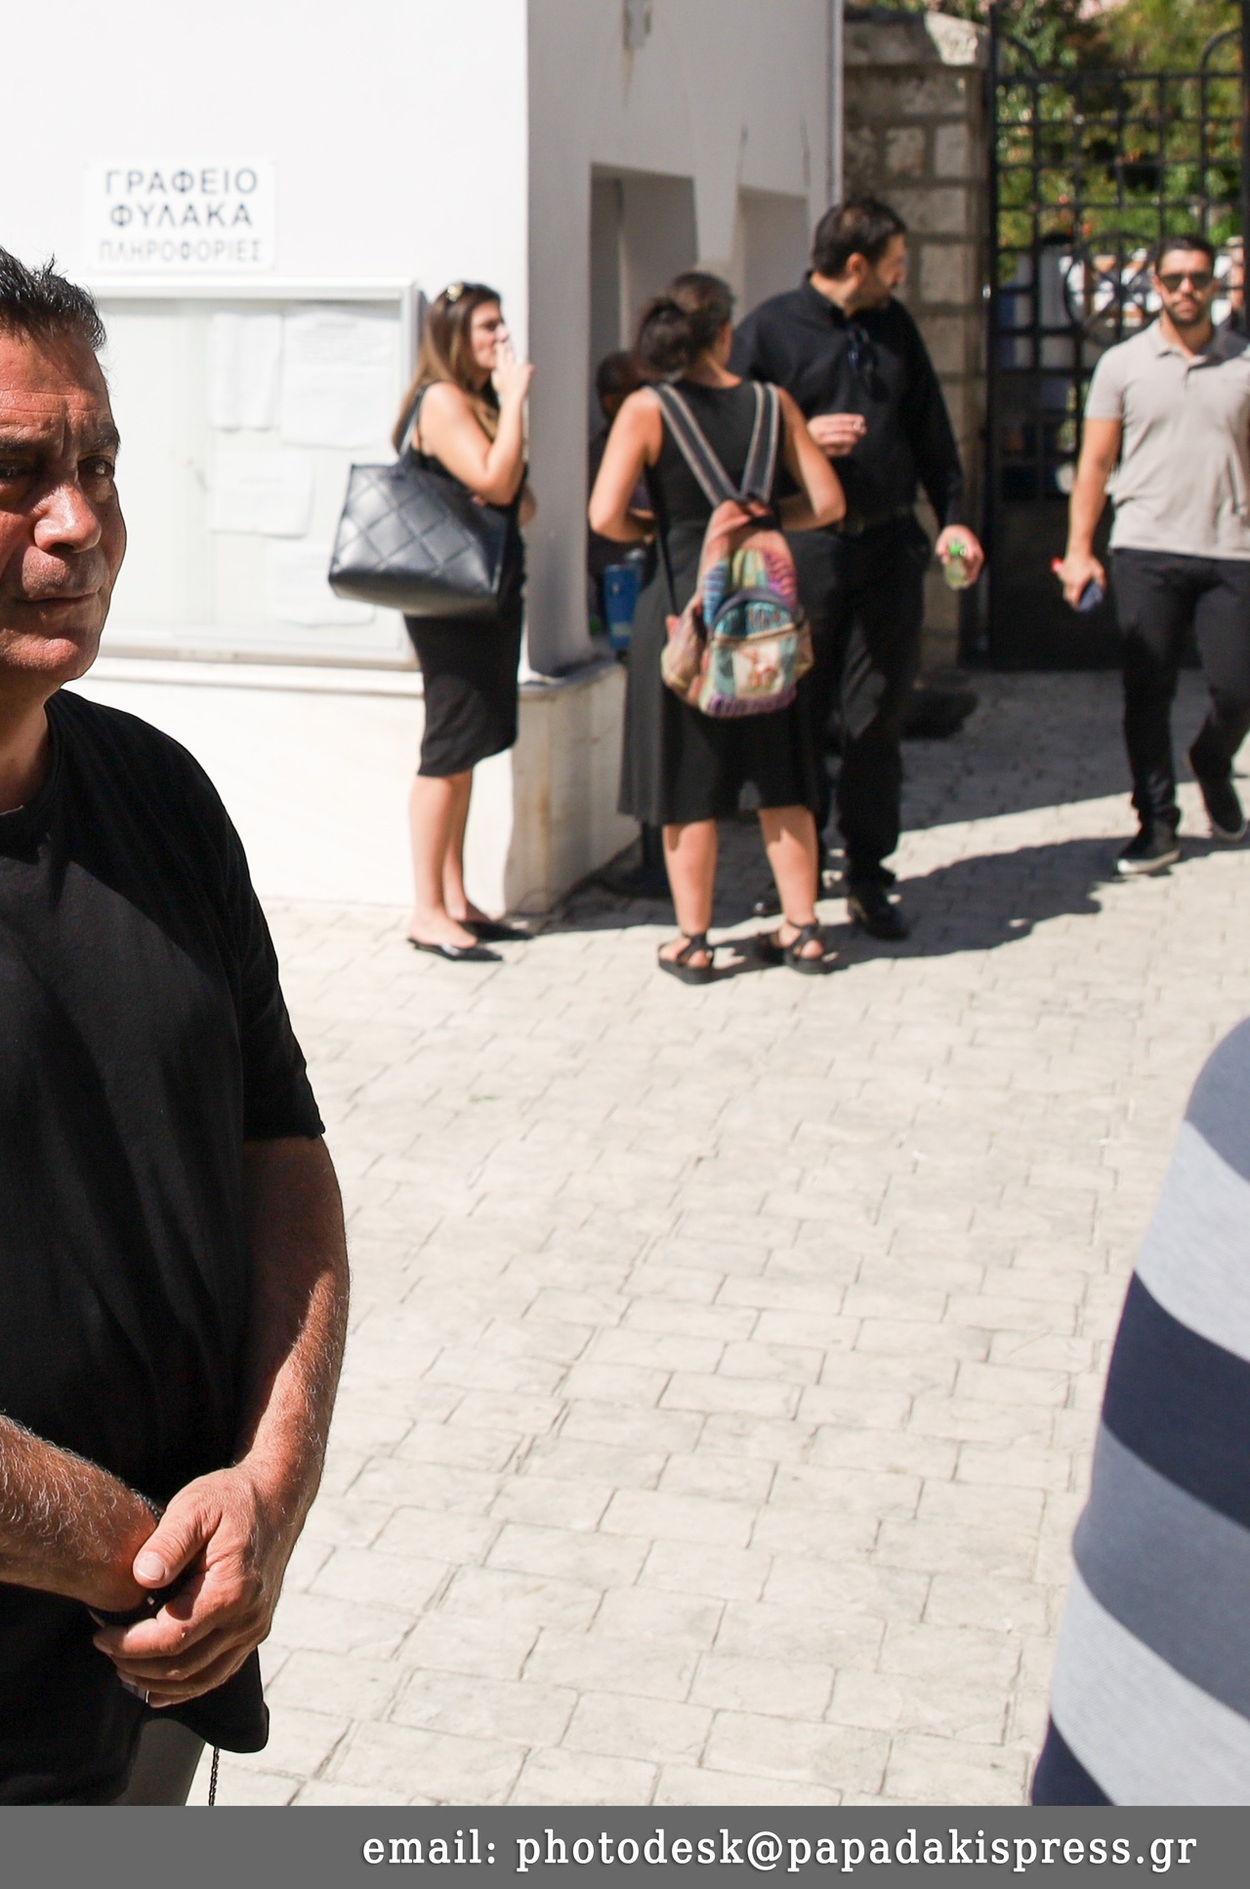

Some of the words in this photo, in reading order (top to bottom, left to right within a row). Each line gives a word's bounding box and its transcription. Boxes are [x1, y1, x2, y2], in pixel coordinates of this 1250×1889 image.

[105, 168, 258, 195] ΓΡΑΦΕΙΟ
[110, 203, 253, 228] ΦΥΛΑΚΑ
[99, 239, 262, 262] ΠΛΗΡΟΦΟΡΙΕΣ
